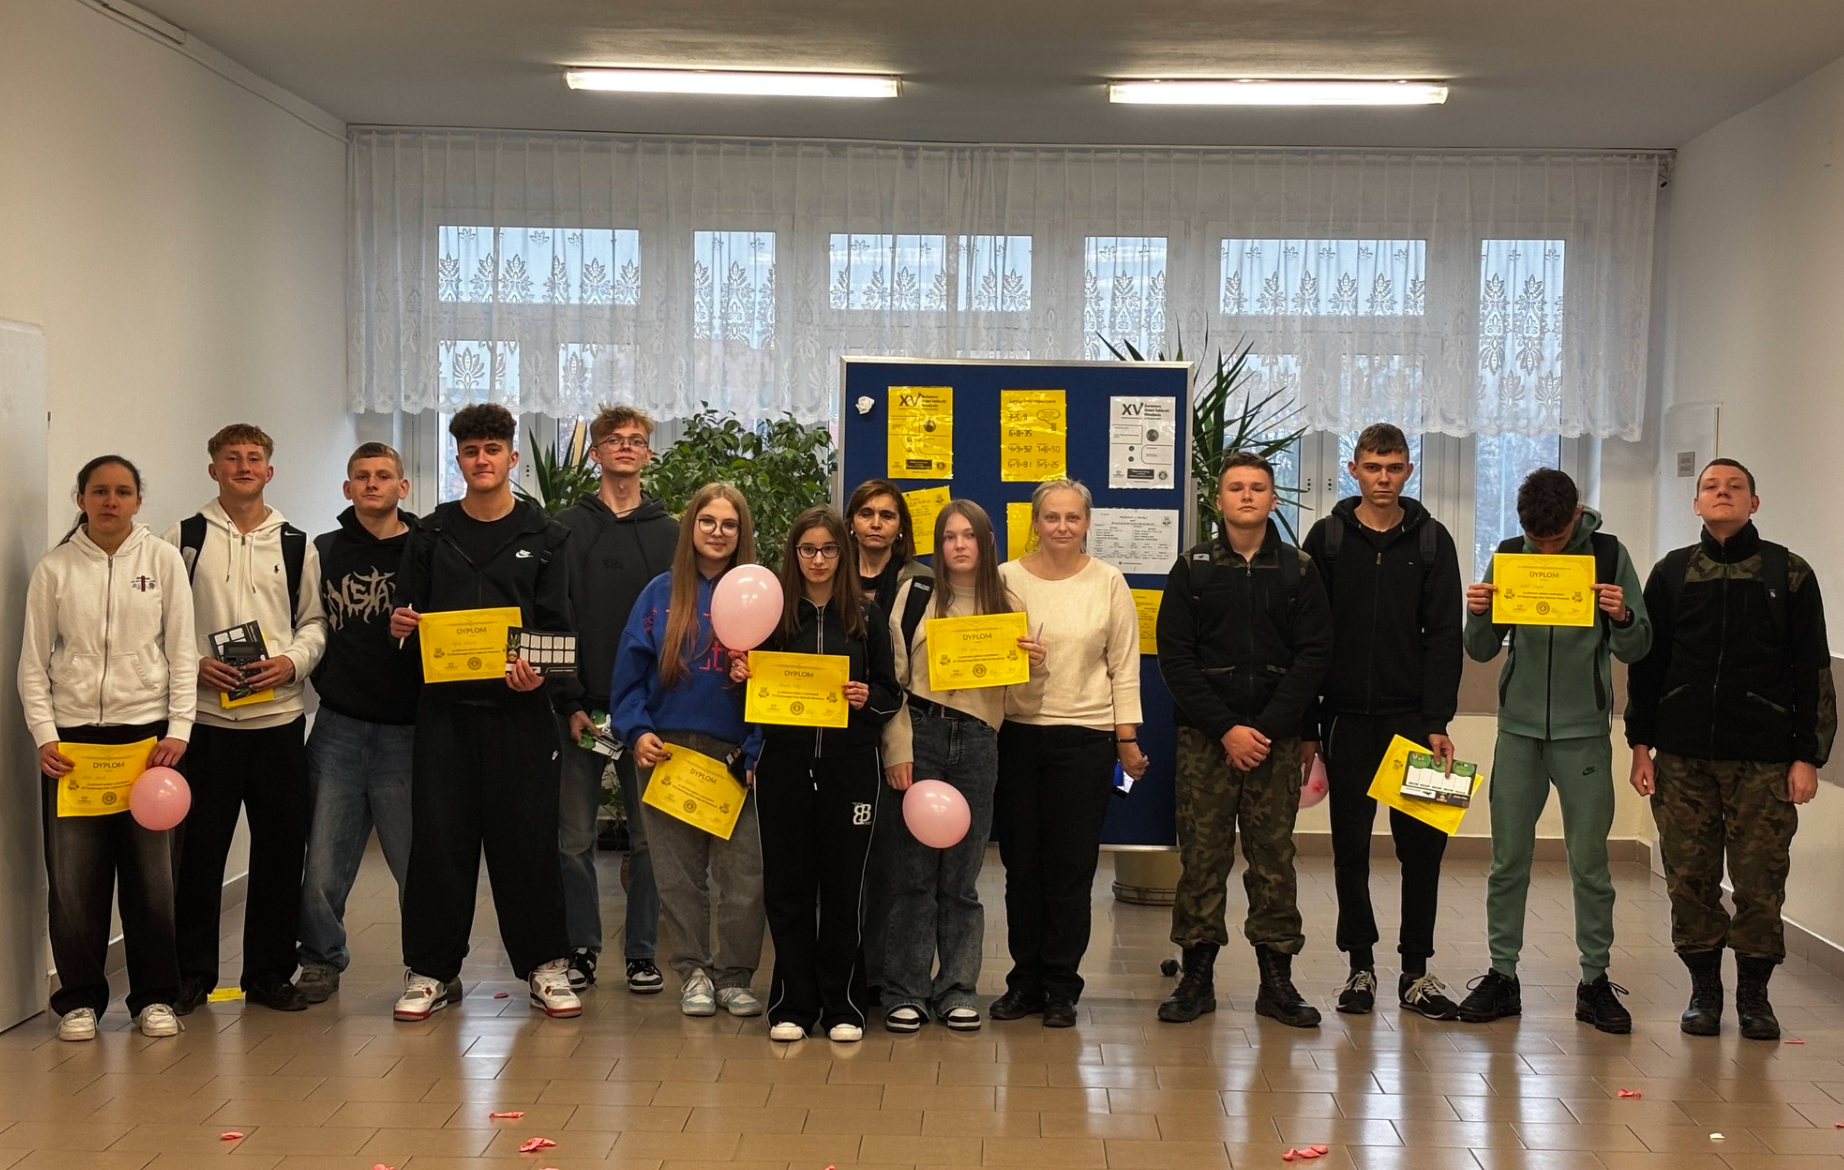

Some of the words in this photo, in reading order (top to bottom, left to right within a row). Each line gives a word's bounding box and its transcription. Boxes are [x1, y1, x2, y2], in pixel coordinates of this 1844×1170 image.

[899, 392, 921, 407] XV
[1121, 402, 1143, 416] XV
[456, 627, 487, 635] DYPLOM
[784, 670, 814, 678] DYPLOM
[690, 768, 717, 784] DYPLOM
